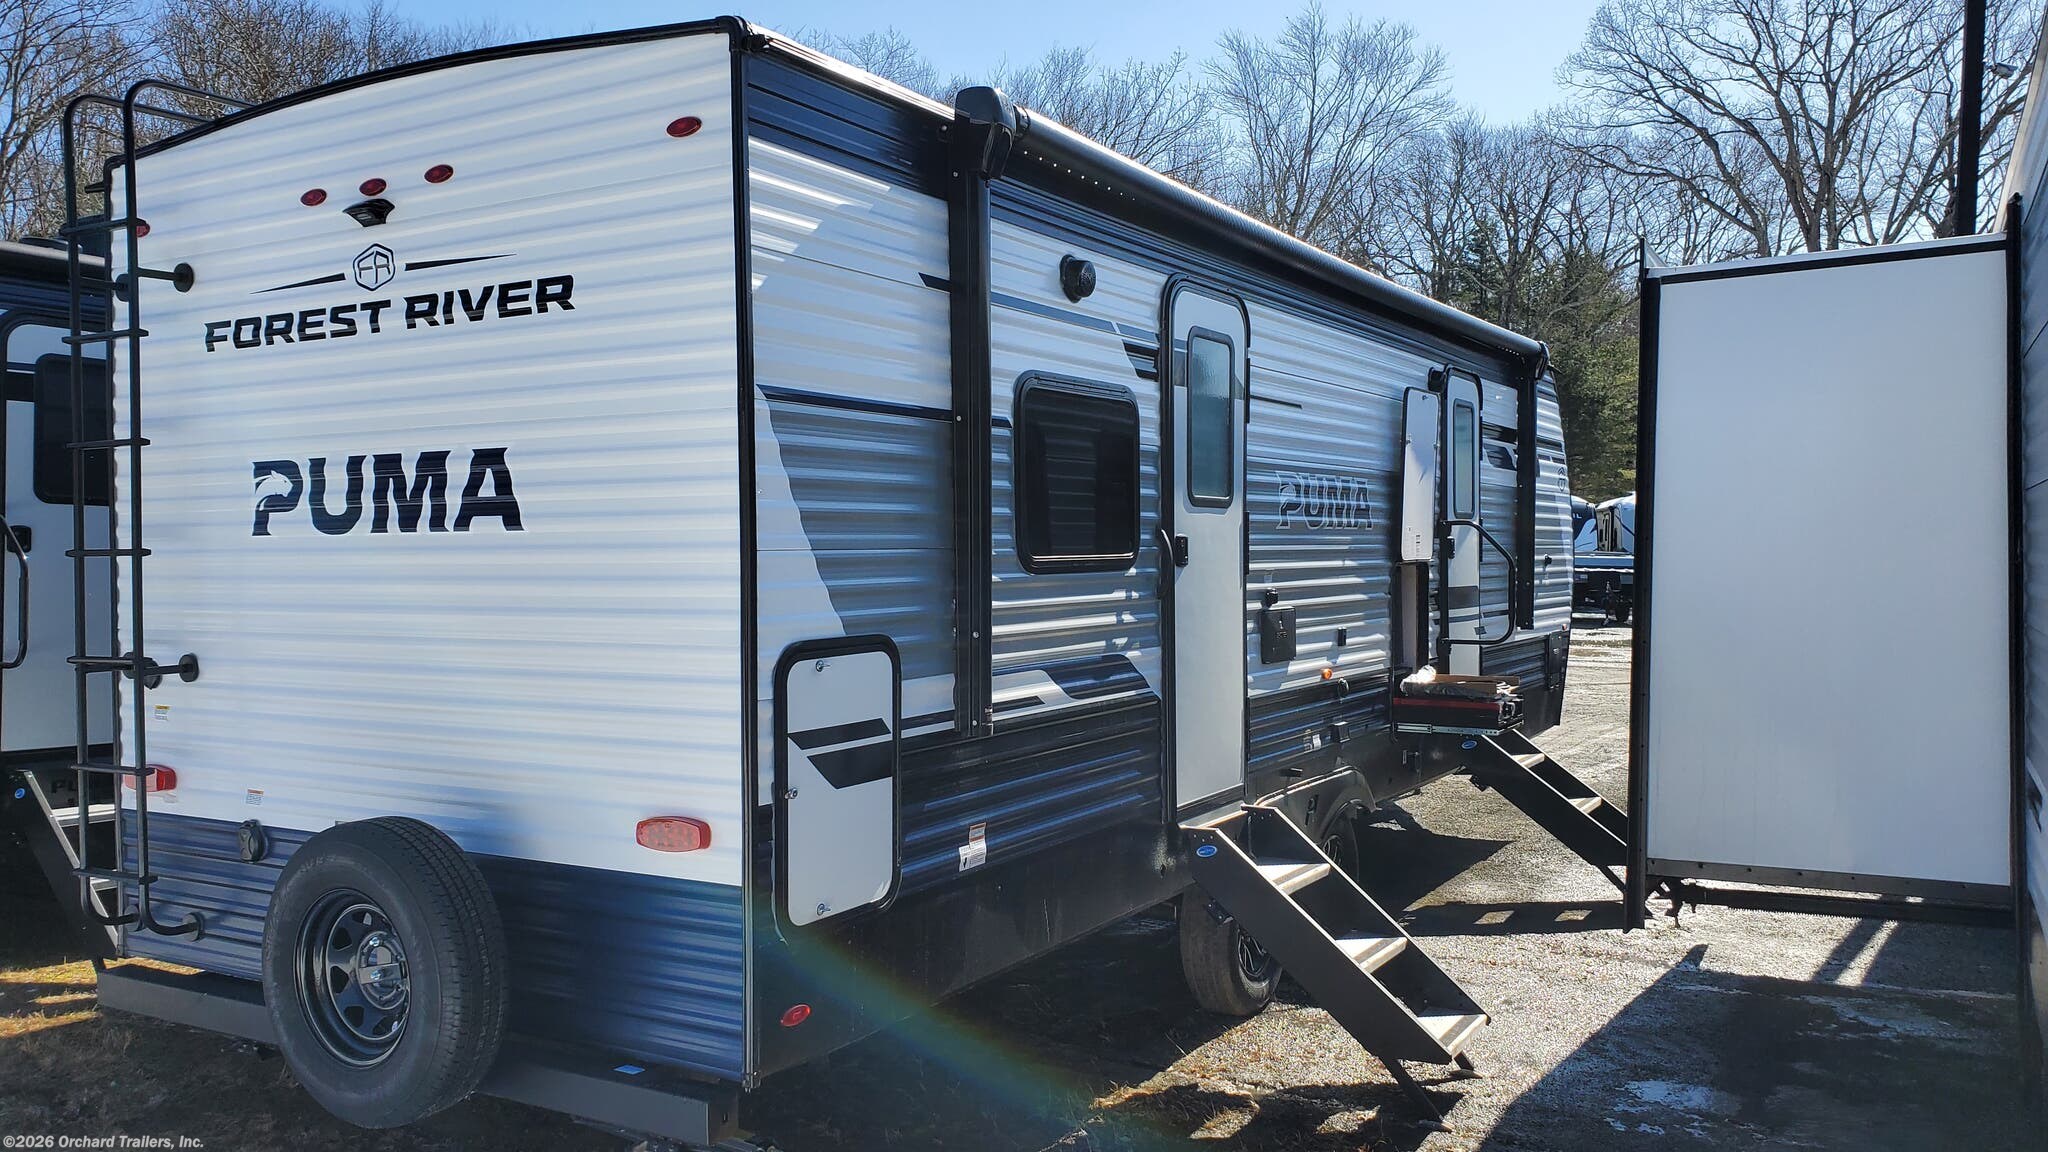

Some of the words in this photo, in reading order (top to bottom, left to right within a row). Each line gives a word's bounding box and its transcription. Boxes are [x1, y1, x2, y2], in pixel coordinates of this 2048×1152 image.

[205, 300, 391, 352] FOREST
[404, 275, 575, 329] RIVER
[252, 447, 525, 535] PUMA
[1275, 471, 1373, 530] PUMA
